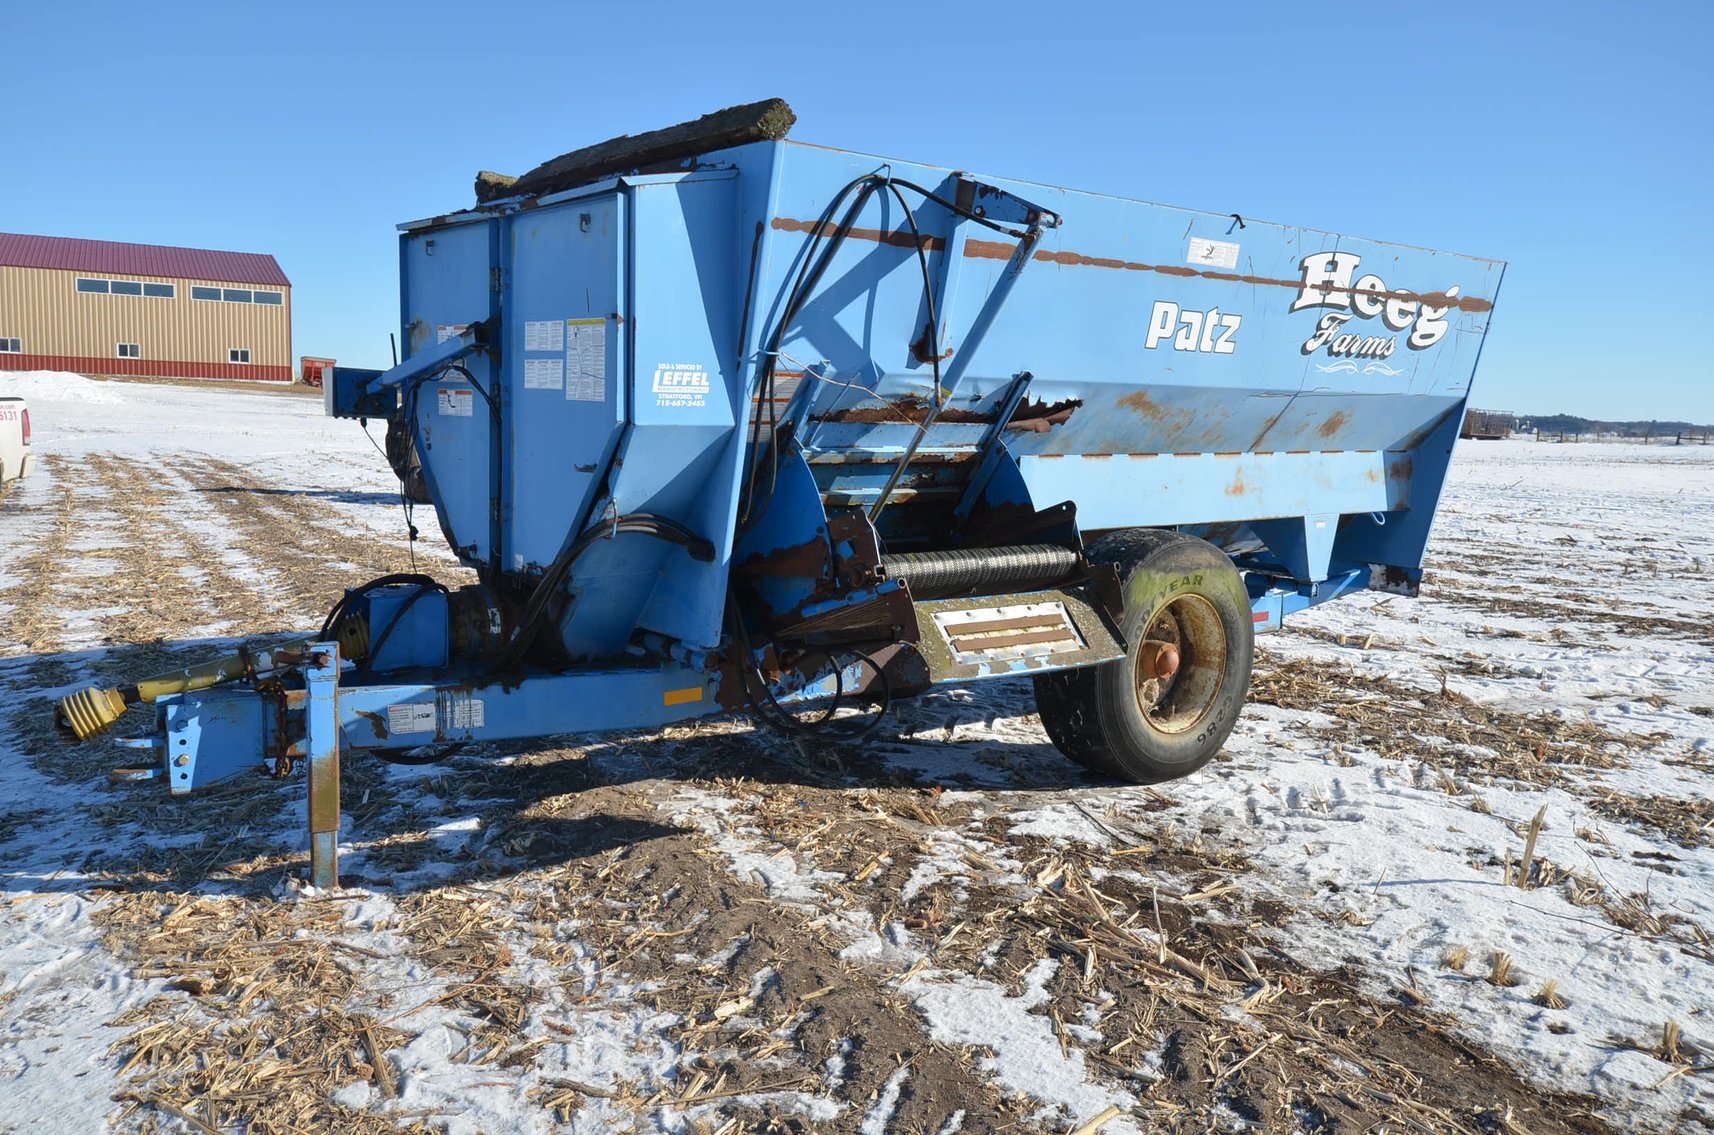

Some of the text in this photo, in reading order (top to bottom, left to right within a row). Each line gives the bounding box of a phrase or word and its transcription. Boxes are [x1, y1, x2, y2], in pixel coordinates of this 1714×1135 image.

[1288, 251, 1460, 350] Heeg
[1144, 300, 1242, 354] Patz
[1301, 311, 1396, 359] Farms
[652, 369, 710, 392] LEFFEL
